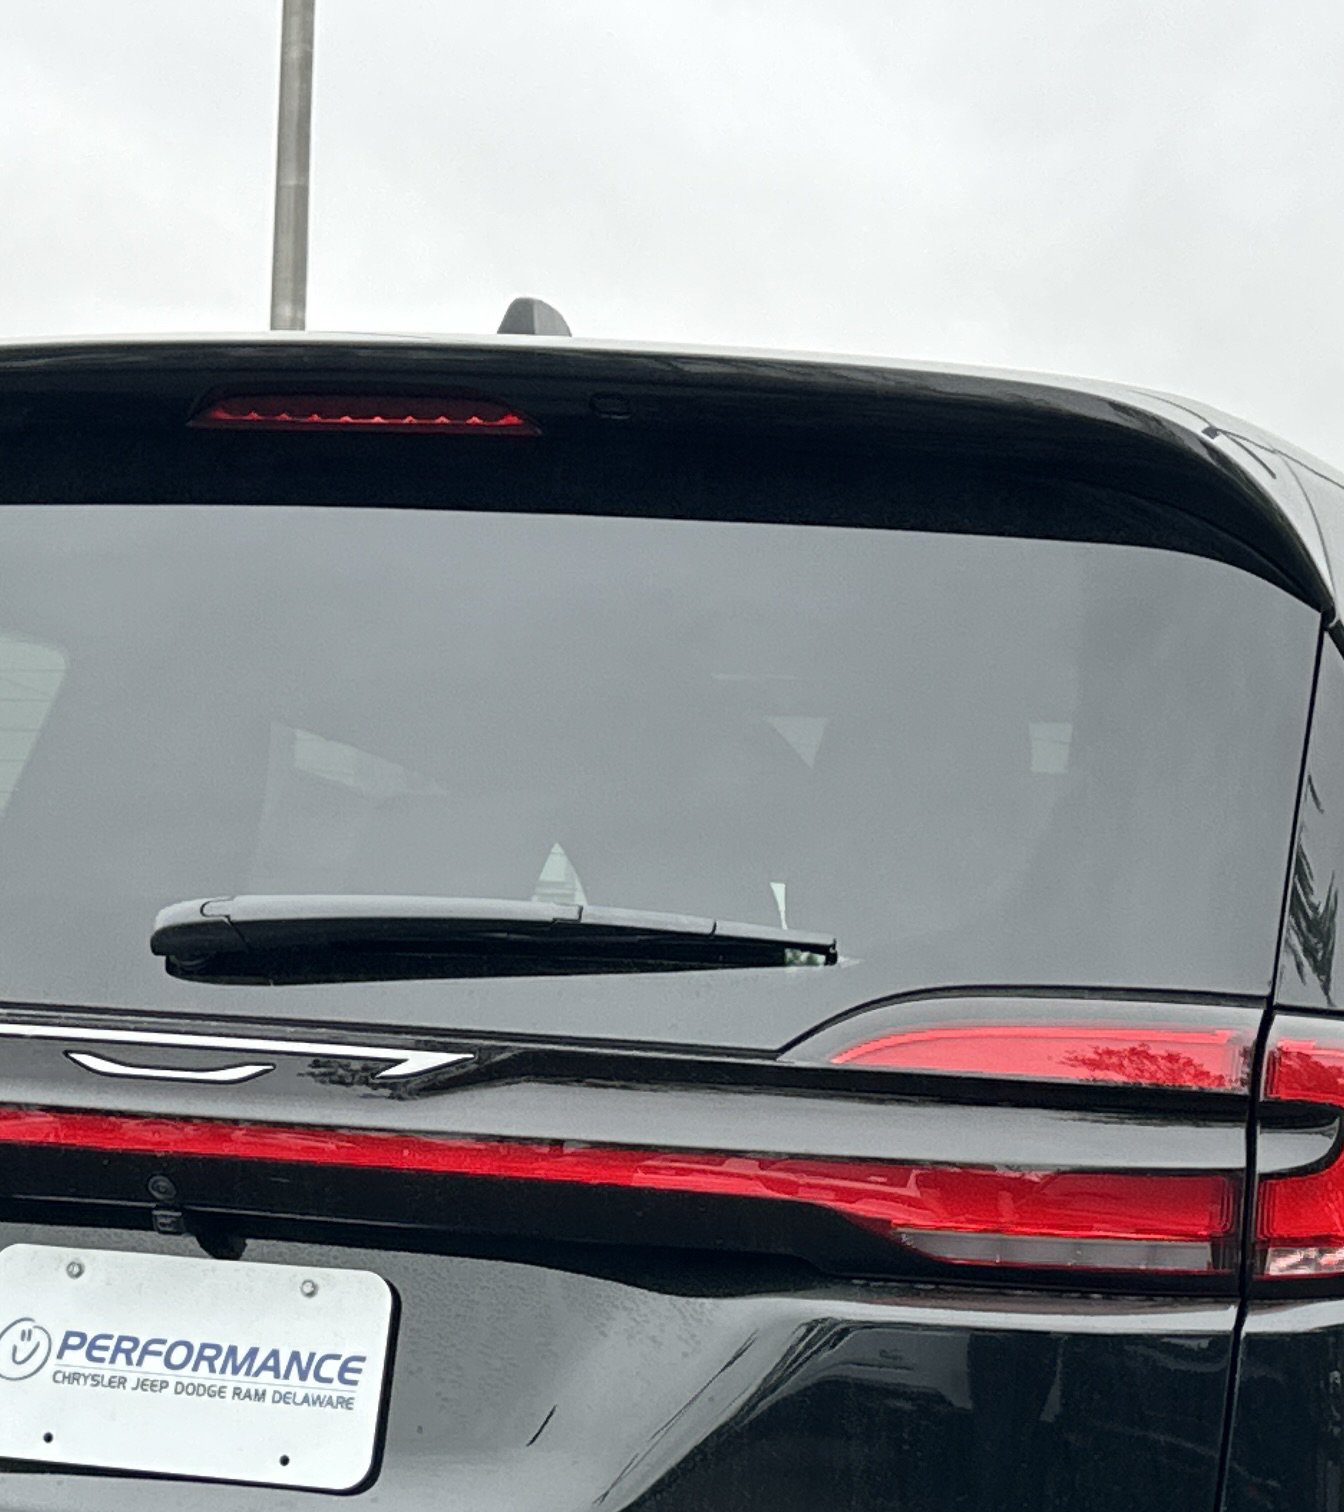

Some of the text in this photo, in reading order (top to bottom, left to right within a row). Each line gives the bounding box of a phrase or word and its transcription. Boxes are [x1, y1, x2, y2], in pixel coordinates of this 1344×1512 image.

[56, 1330, 367, 1386] PERFORMANCE
[52, 1369, 355, 1411] CHRYSLER JEEP DODGE RAM DELAWARE
